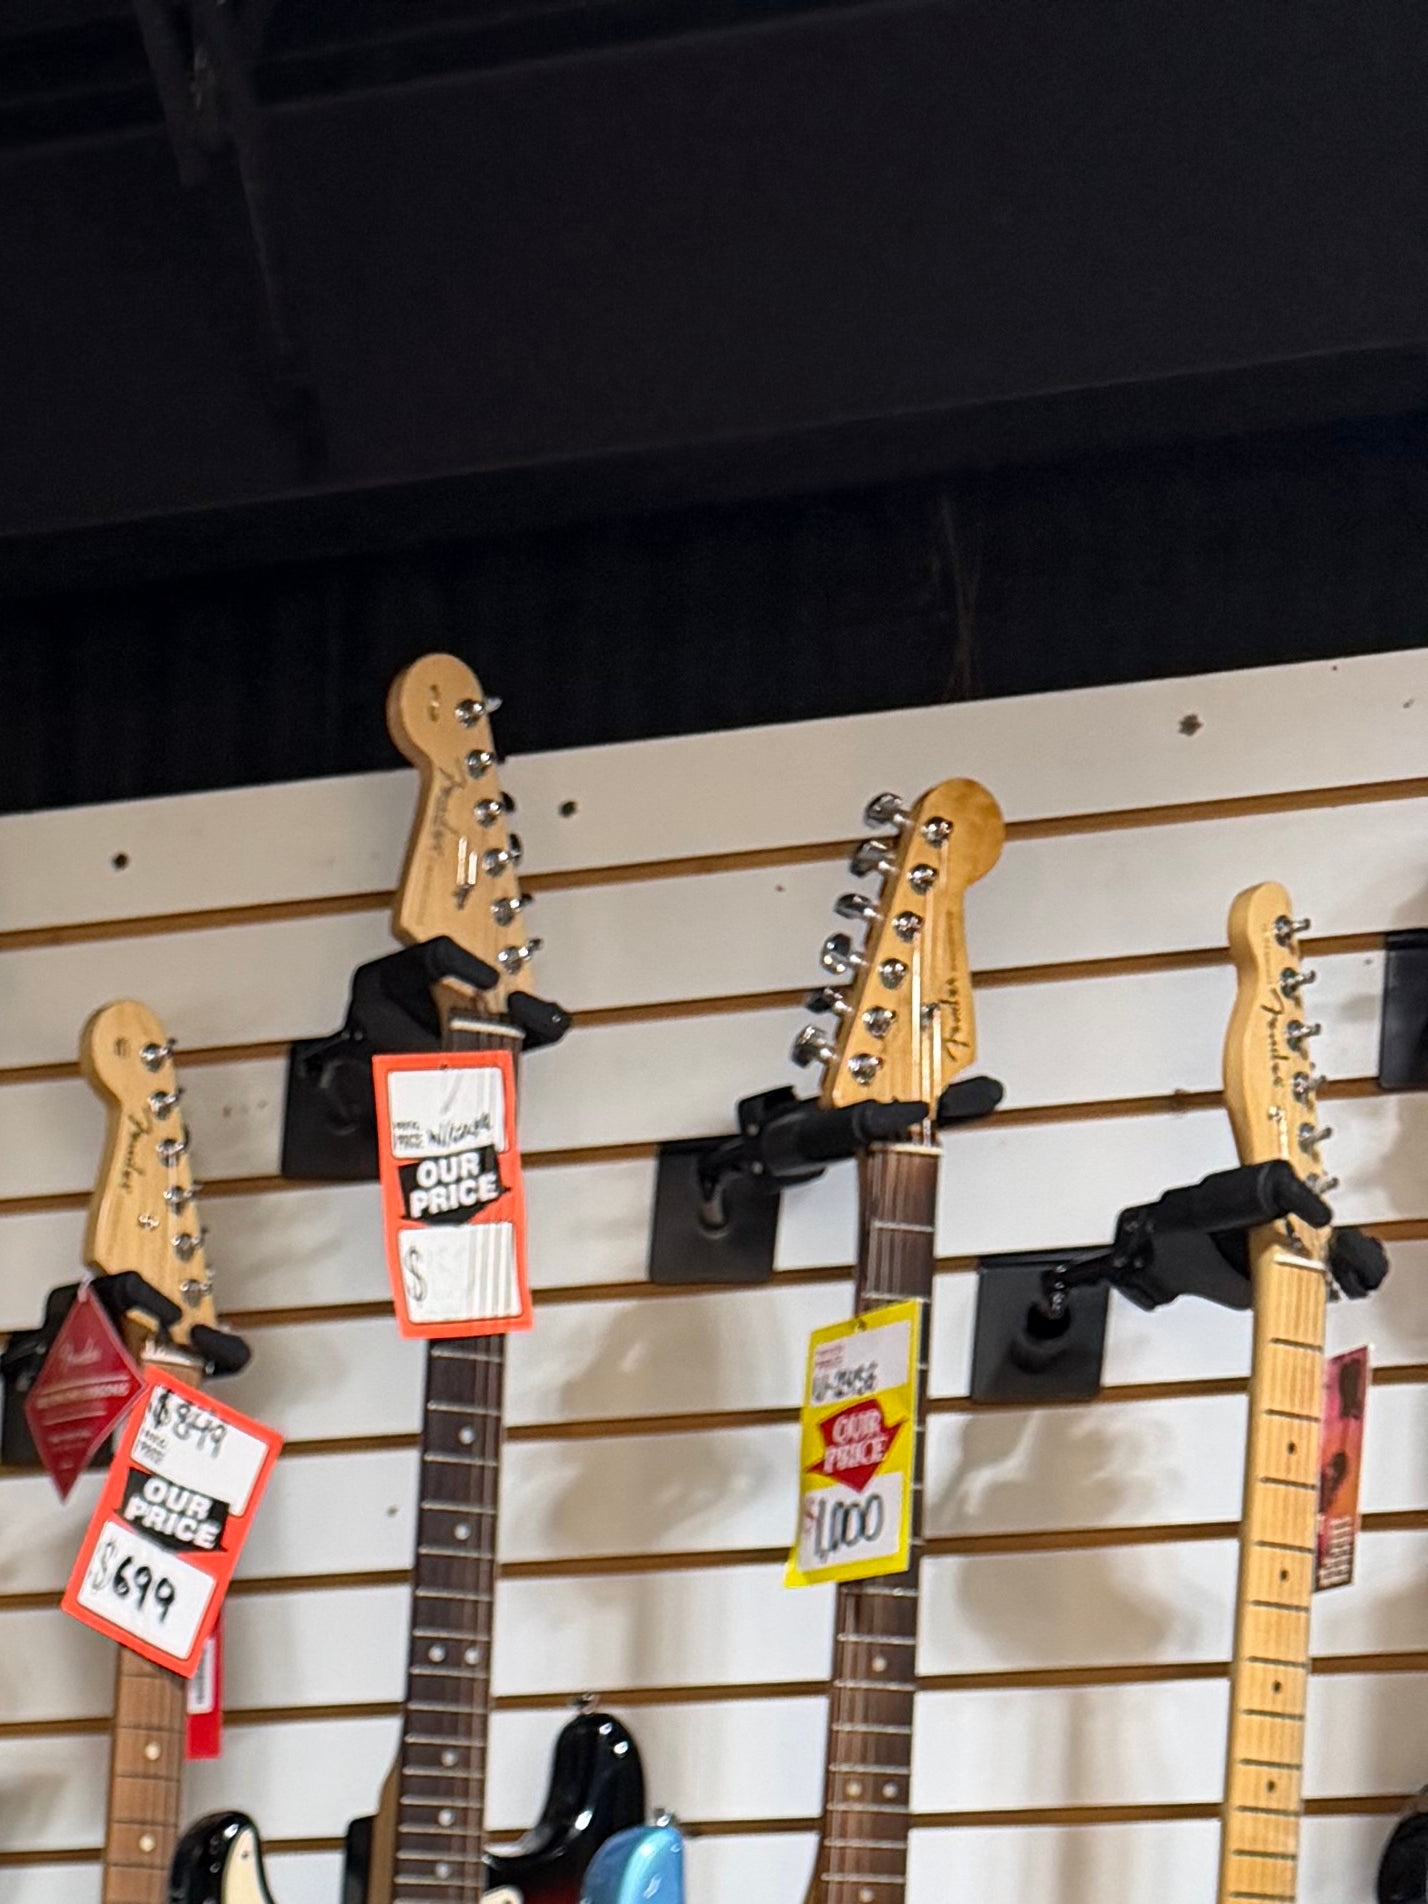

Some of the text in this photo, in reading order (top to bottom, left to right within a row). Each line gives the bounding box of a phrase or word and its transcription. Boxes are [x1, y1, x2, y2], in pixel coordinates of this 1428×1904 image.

[1259, 986, 1290, 1088] Fender
[415, 1151, 481, 1189] OUR
[408, 1171, 499, 1220] PRICE
[830, 1407, 884, 1446] OUR
[822, 1434, 889, 1475] PRICE
[143, 1475, 213, 1520] OUR
[123, 1495, 222, 1550] PRICE
[91, 1539, 176, 1623] $699
